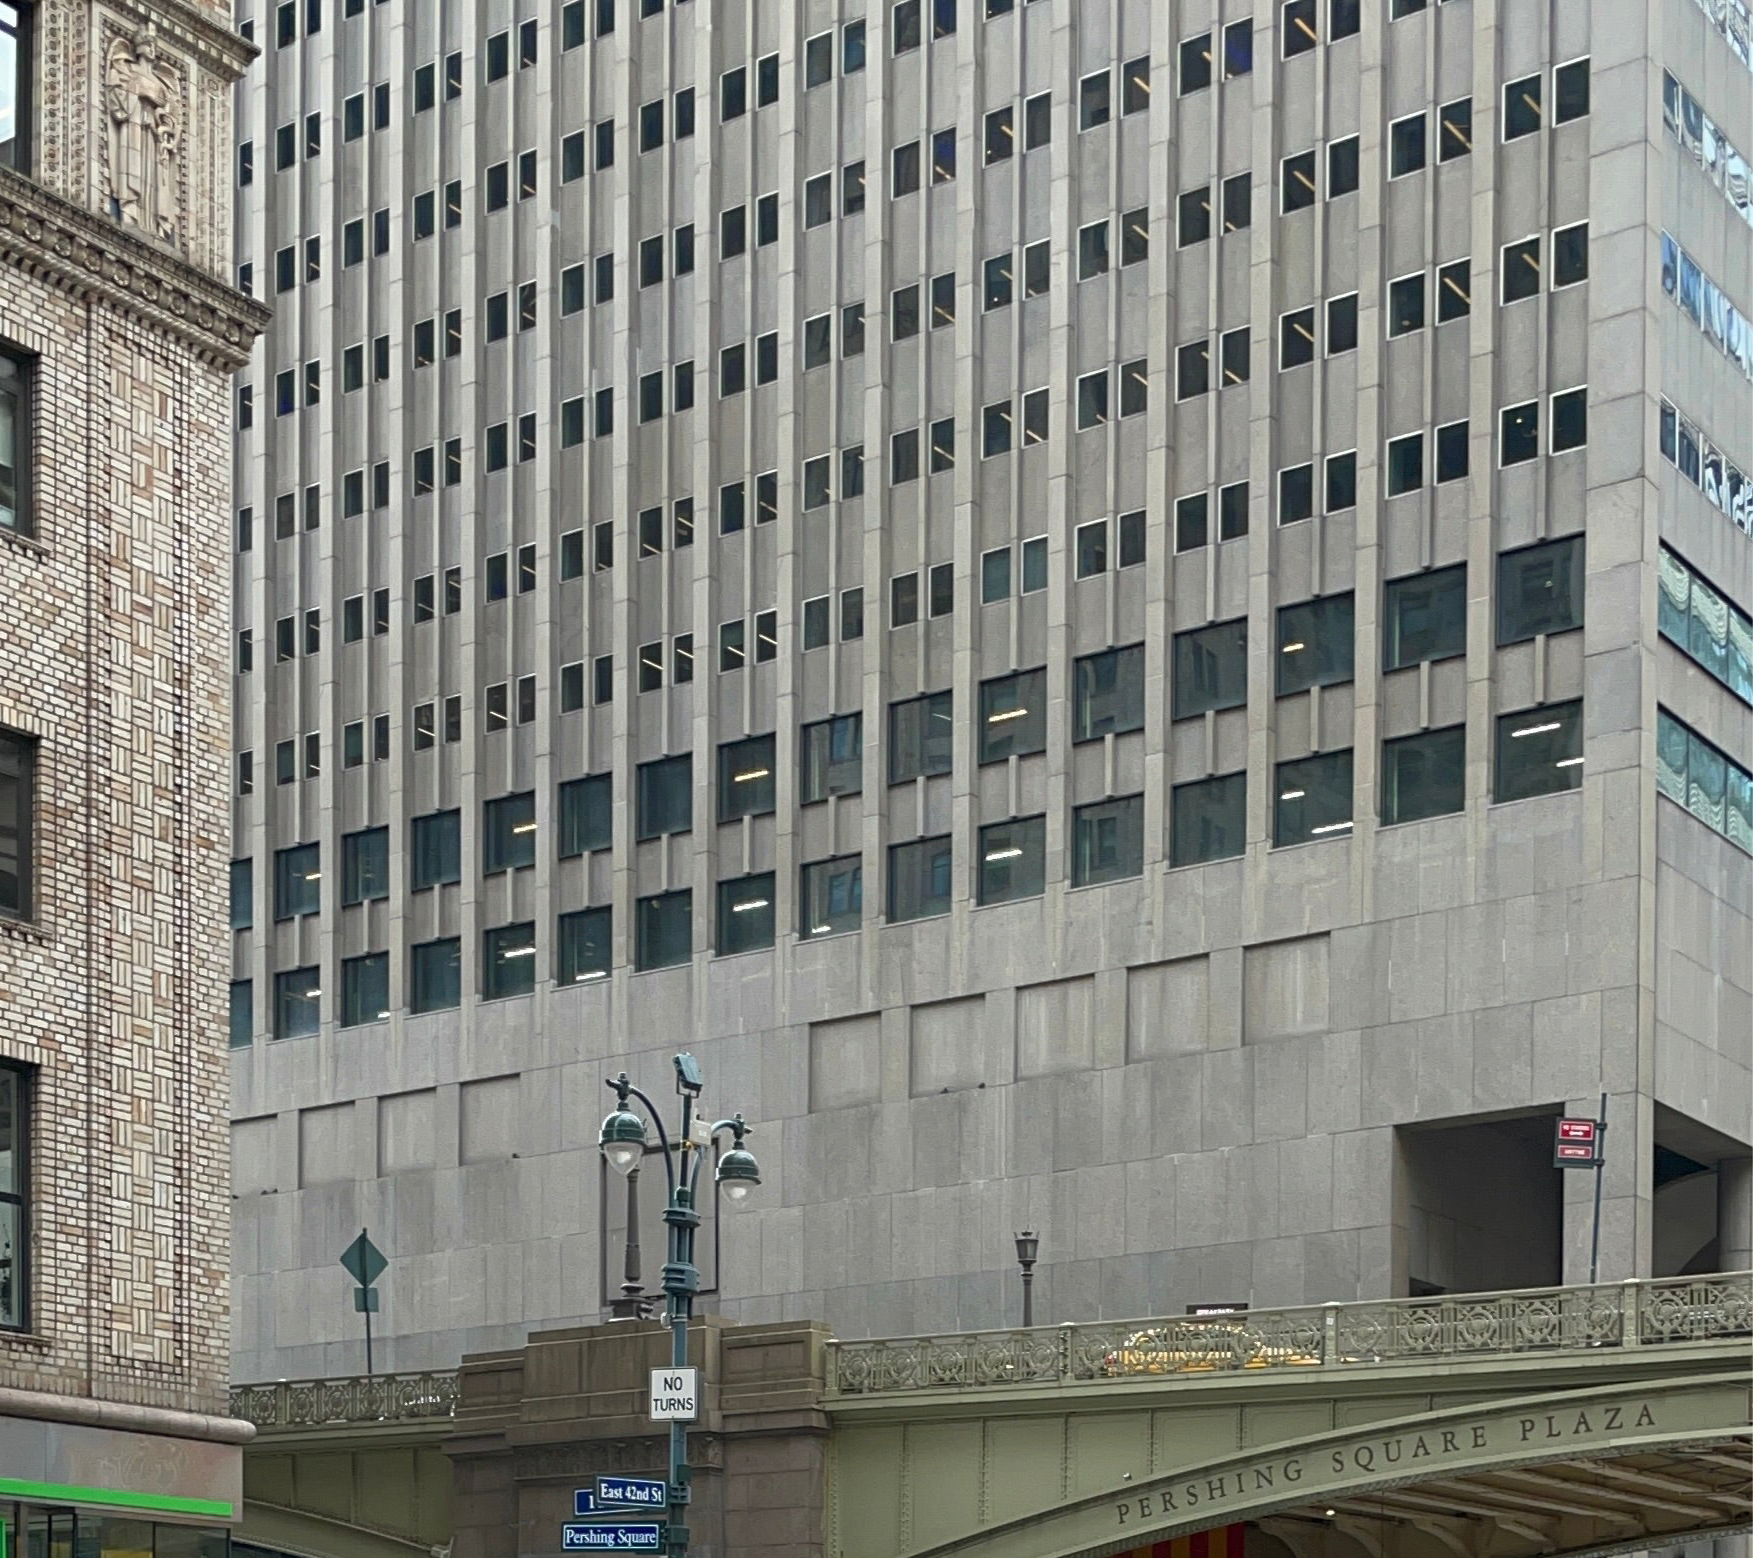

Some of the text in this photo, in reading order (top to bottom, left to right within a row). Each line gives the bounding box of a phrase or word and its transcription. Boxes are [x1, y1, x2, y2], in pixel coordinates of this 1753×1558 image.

[663, 1376, 683, 1391] NO
[653, 1398, 693, 1411] TURNS
[1117, 1404, 1655, 1524] PERSHING SQUARE PLAZA
[601, 1483, 662, 1502] East 42nd St
[565, 1529, 656, 1547] Pershing Square
